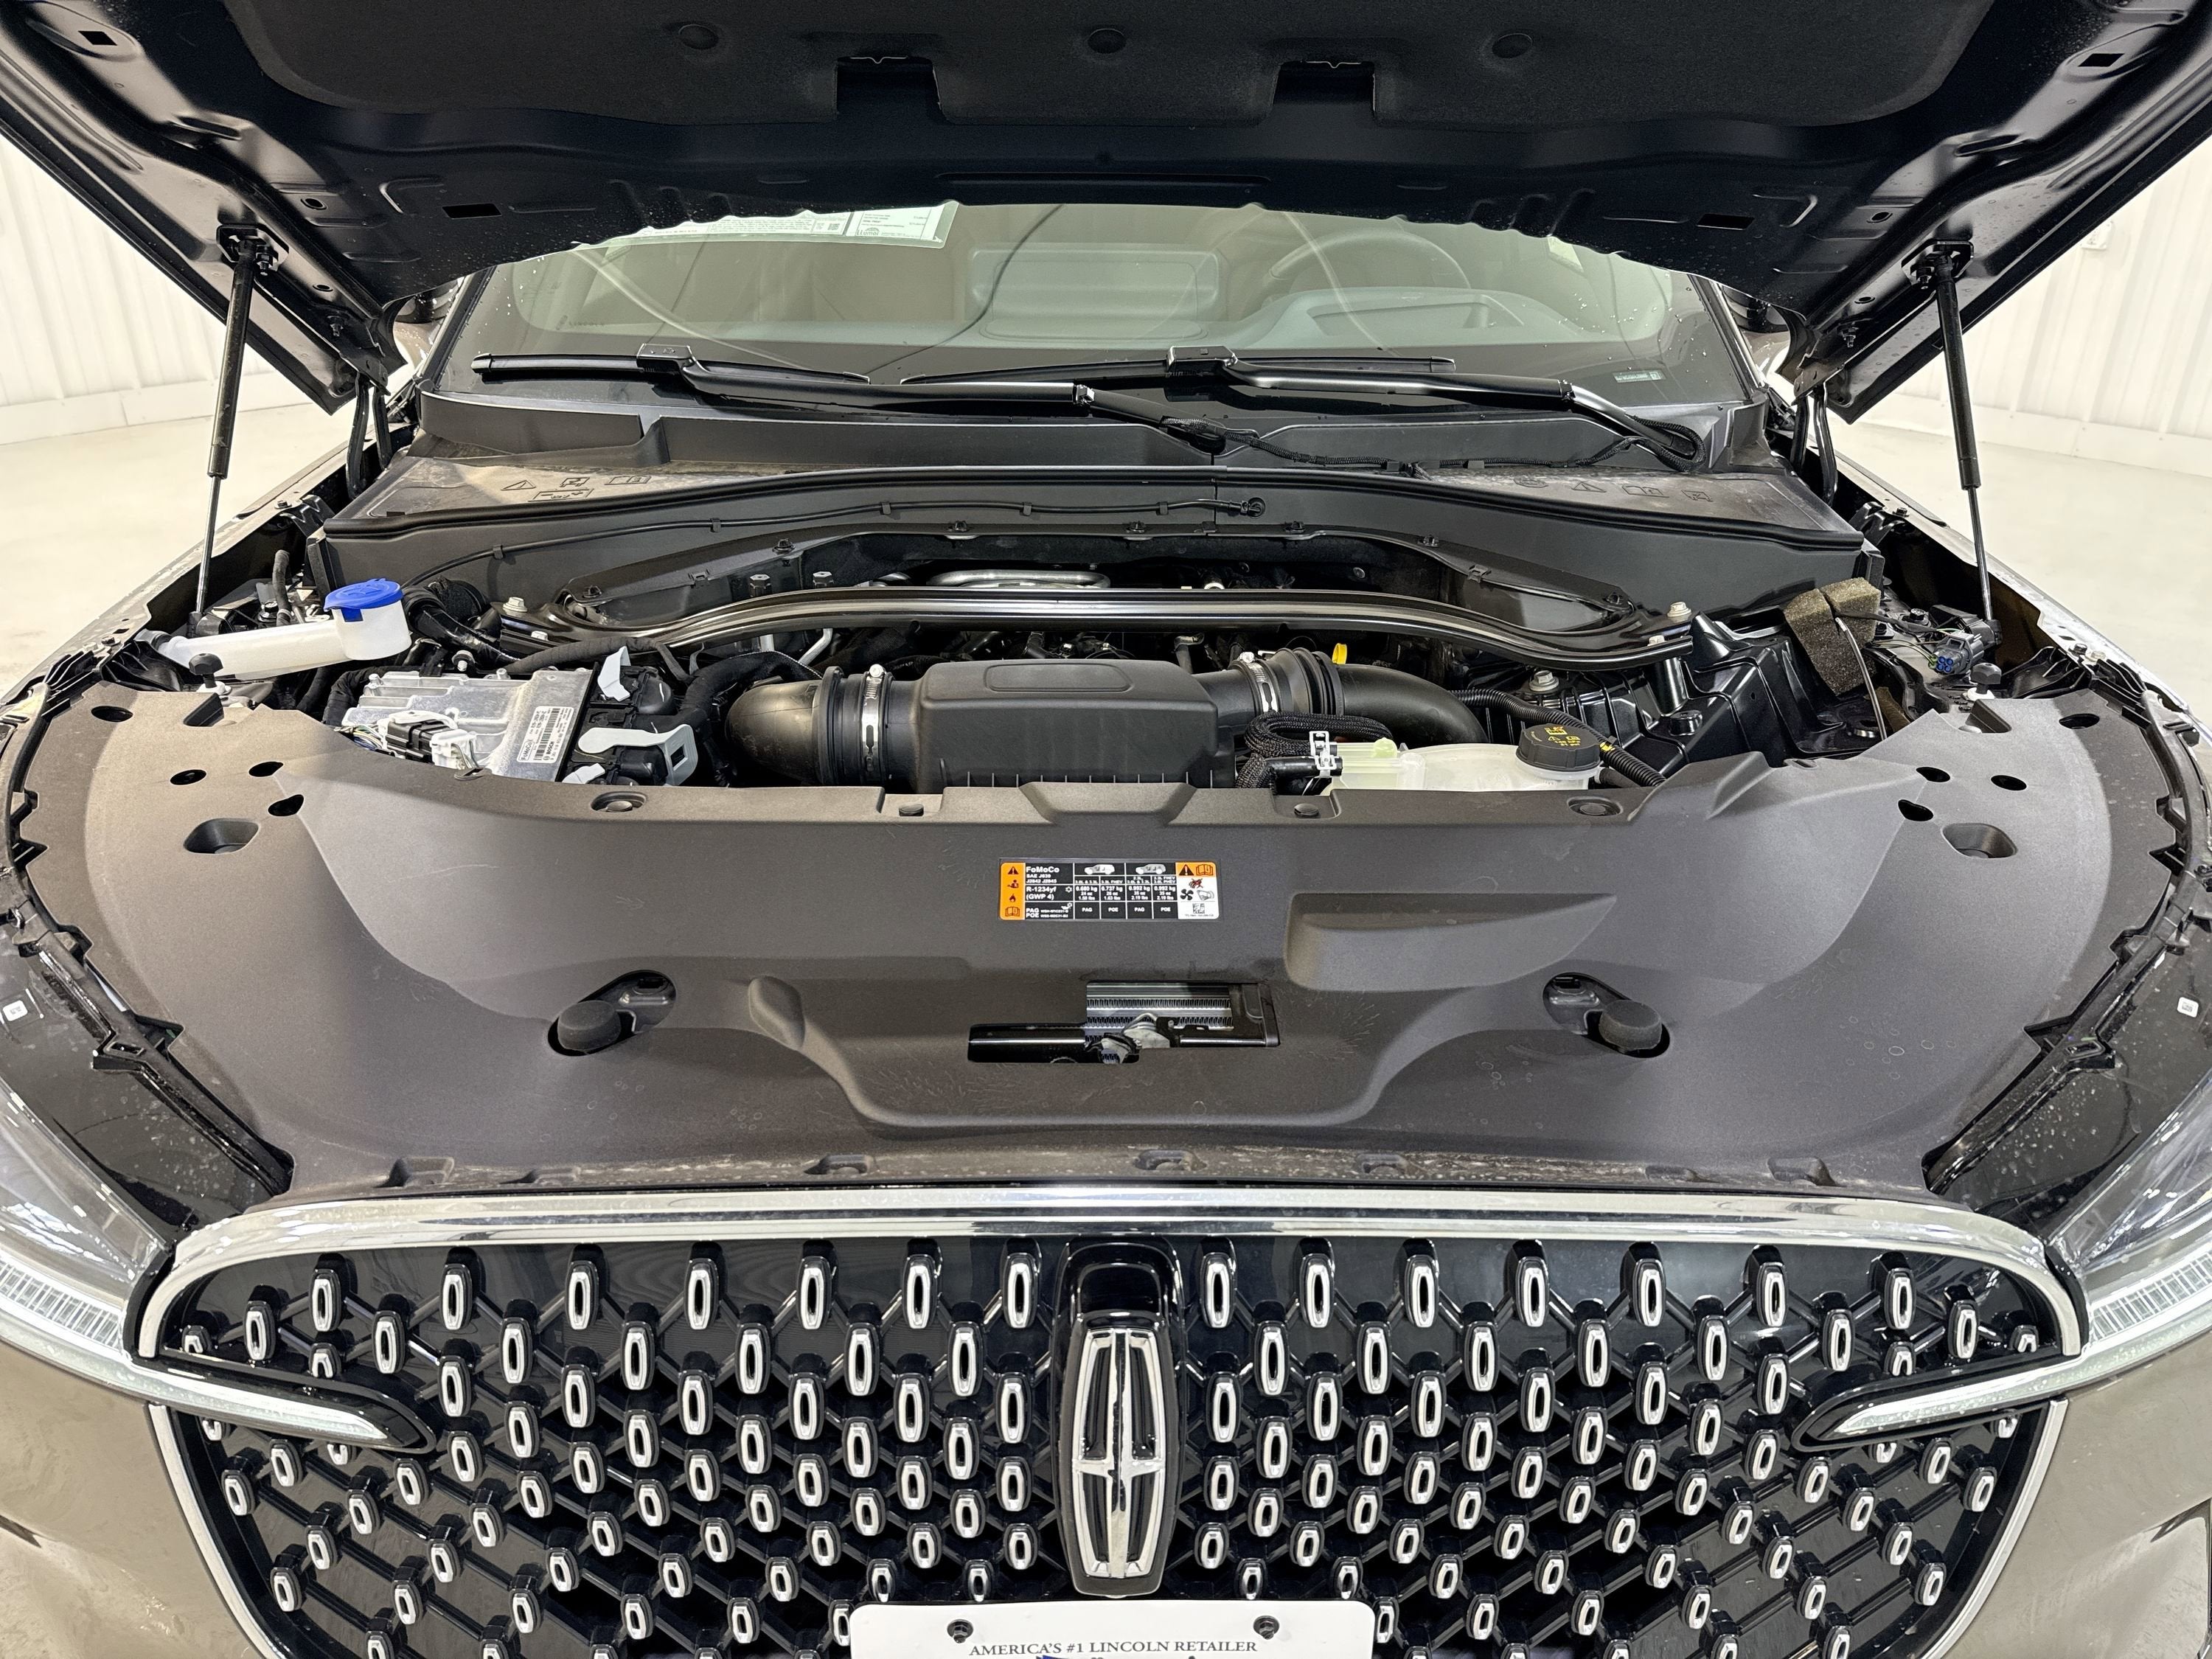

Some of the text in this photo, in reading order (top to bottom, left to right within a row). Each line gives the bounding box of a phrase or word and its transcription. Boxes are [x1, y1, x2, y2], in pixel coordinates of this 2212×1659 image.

[546, 741, 554, 754] BOSCH
[969, 1641, 1258, 1656] AMERICA'S #1 LINCOLN RETAILER
